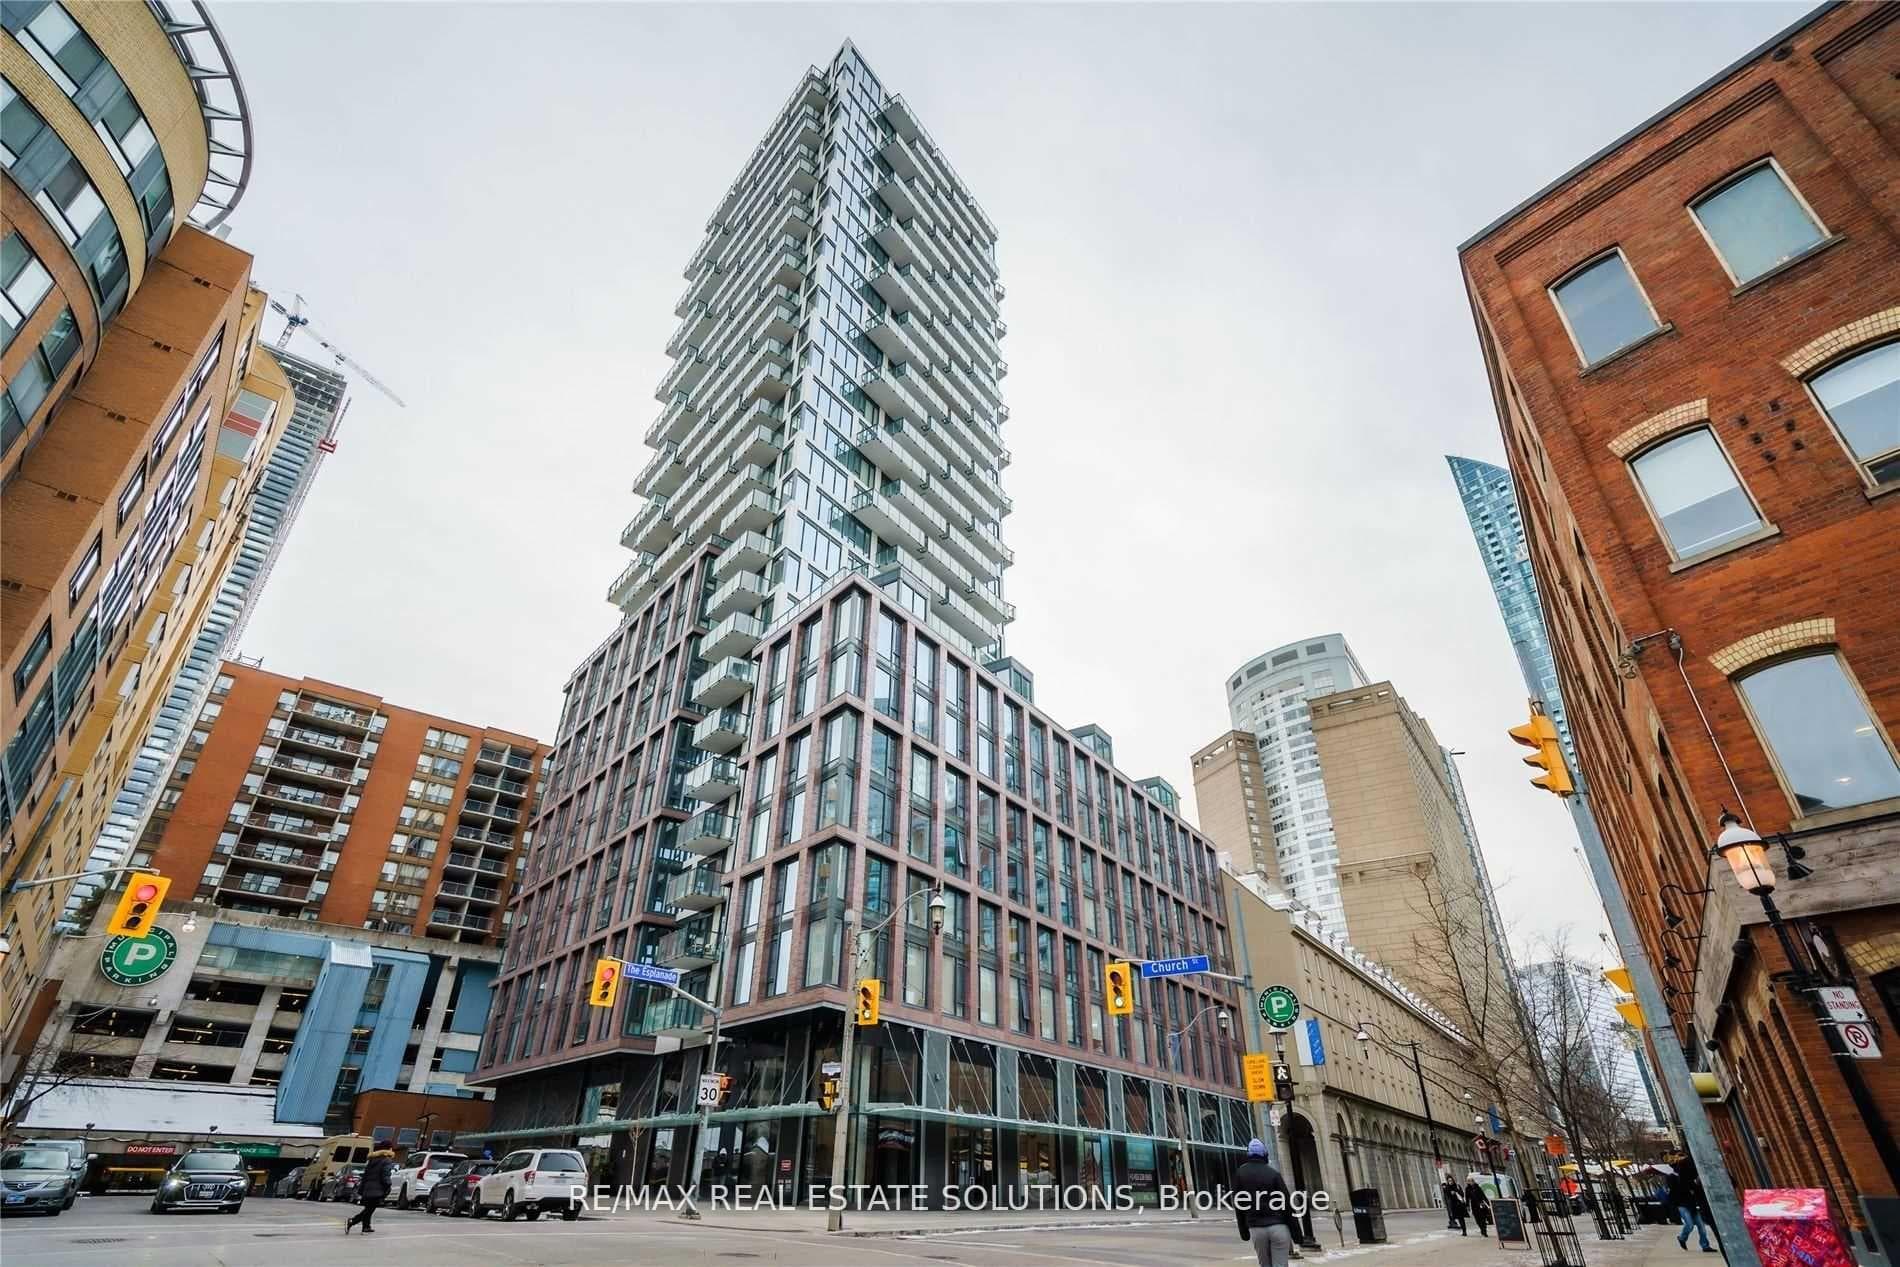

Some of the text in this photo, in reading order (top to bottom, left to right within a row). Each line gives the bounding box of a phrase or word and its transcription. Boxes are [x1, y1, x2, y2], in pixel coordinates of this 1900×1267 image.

[123, 942, 157, 966] P
[104, 956, 169, 984] PARKING
[627, 964, 677, 982] The Esplanade
[1151, 960, 1189, 973] Church
[1832, 990, 1845, 999] NO
[1271, 996, 1287, 1014] P
[1827, 1000, 1860, 1010] STANDING
[700, 1087, 717, 1101] 30
